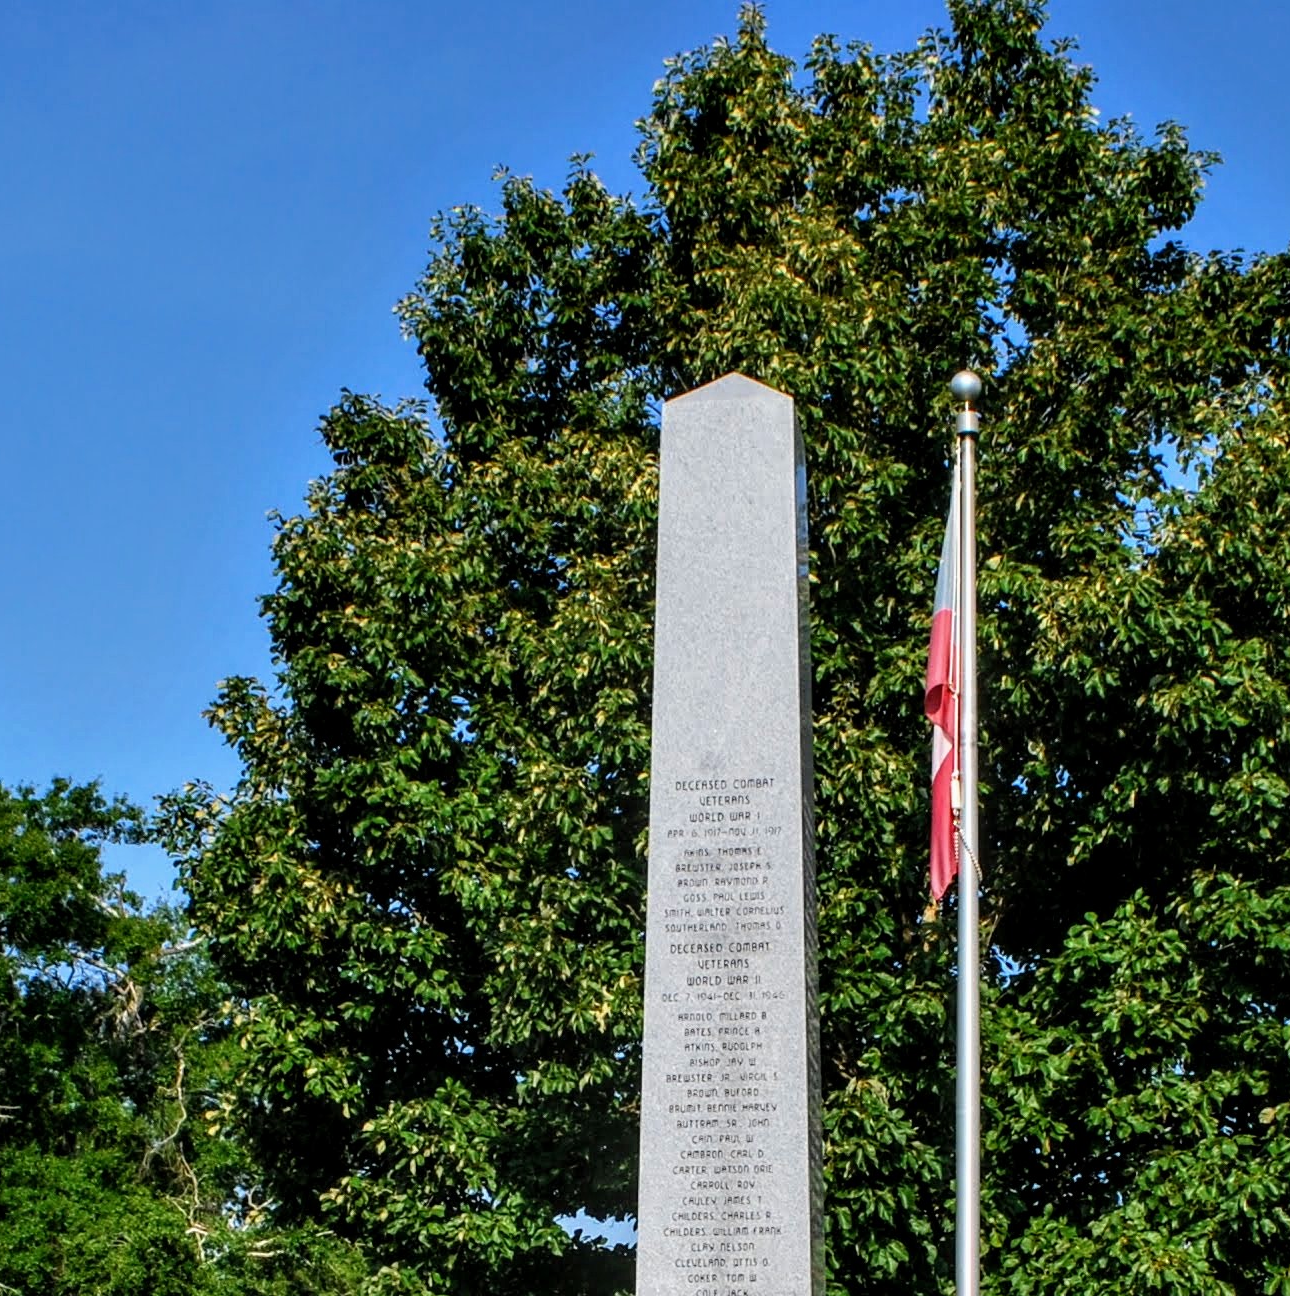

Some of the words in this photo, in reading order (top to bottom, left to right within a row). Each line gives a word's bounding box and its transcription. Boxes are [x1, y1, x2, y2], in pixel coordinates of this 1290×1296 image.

[675, 779, 727, 791] DECEASED
[733, 778, 775, 789] COMBAT
[699, 795, 751, 806] VETERANS
[689, 812, 724, 822] WORLD
[730, 812, 751, 821] WAR
[729, 862, 761, 871] JOSEPH
[715, 877, 758, 885] RAYMOND
[713, 893, 734, 901] PAUL
[739, 892, 765, 900] LEWIS
[697, 908, 730, 916] WALTER
[736, 906, 785, 915] CORNELIUS
[735, 922, 770, 930] THOMAS
[670, 944, 722, 954] DECEASED
[729, 942, 770, 952] COMBAT
[698, 959, 749, 969] VETERANS
[687, 976, 721, 986] WORLD
[728, 976, 748, 985] WAR
[755, 975, 761, 984] II
[719, 1012, 757, 1020] MILLARD
[725, 1088, 759, 1097] BUFORD
[707, 1104, 737, 1112] BENNIE
[742, 1103, 777, 1112] HARVEY
[719, 1135, 740, 1143] PAUL
[731, 1150, 752, 1158] CARL
[714, 1165, 749, 1174] WATSON
[738, 1181, 755, 1189] ROY
[724, 1196, 751, 1205] JAMES
[721, 1212, 761, 1220] CHARLES
[713, 1227, 748, 1236] WILLIAM
[753, 1227, 781, 1235] FRANK
[720, 1243, 755, 1251] NELSON
[727, 1274, 744, 1282] TOM
